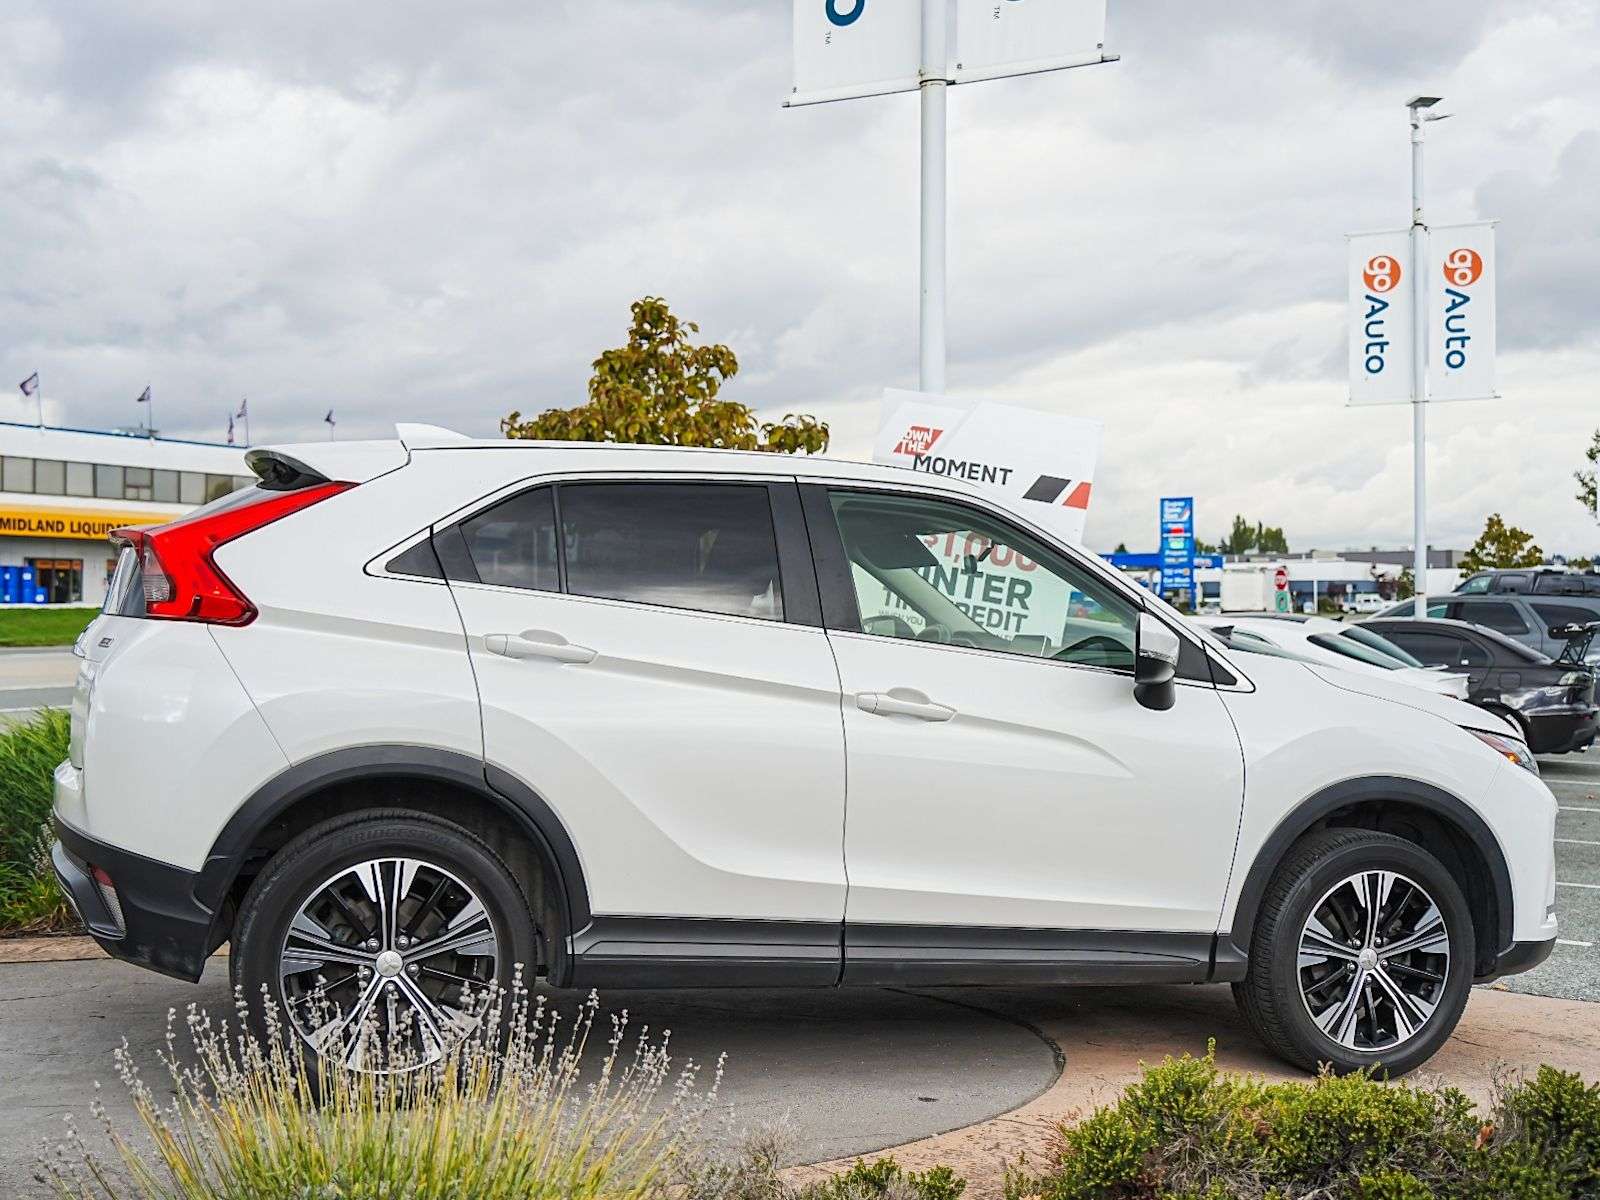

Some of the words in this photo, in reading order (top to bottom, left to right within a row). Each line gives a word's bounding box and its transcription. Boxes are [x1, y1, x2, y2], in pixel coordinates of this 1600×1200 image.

[1365, 294, 1390, 374] Auto
[1445, 288, 1471, 369] Auto
[898, 438, 928, 455] THE
[902, 429, 932, 443] OWN
[912, 454, 1013, 486] MOMENT
[0, 517, 65, 533] MIDLAND
[70, 521, 131, 536] LIQUID
